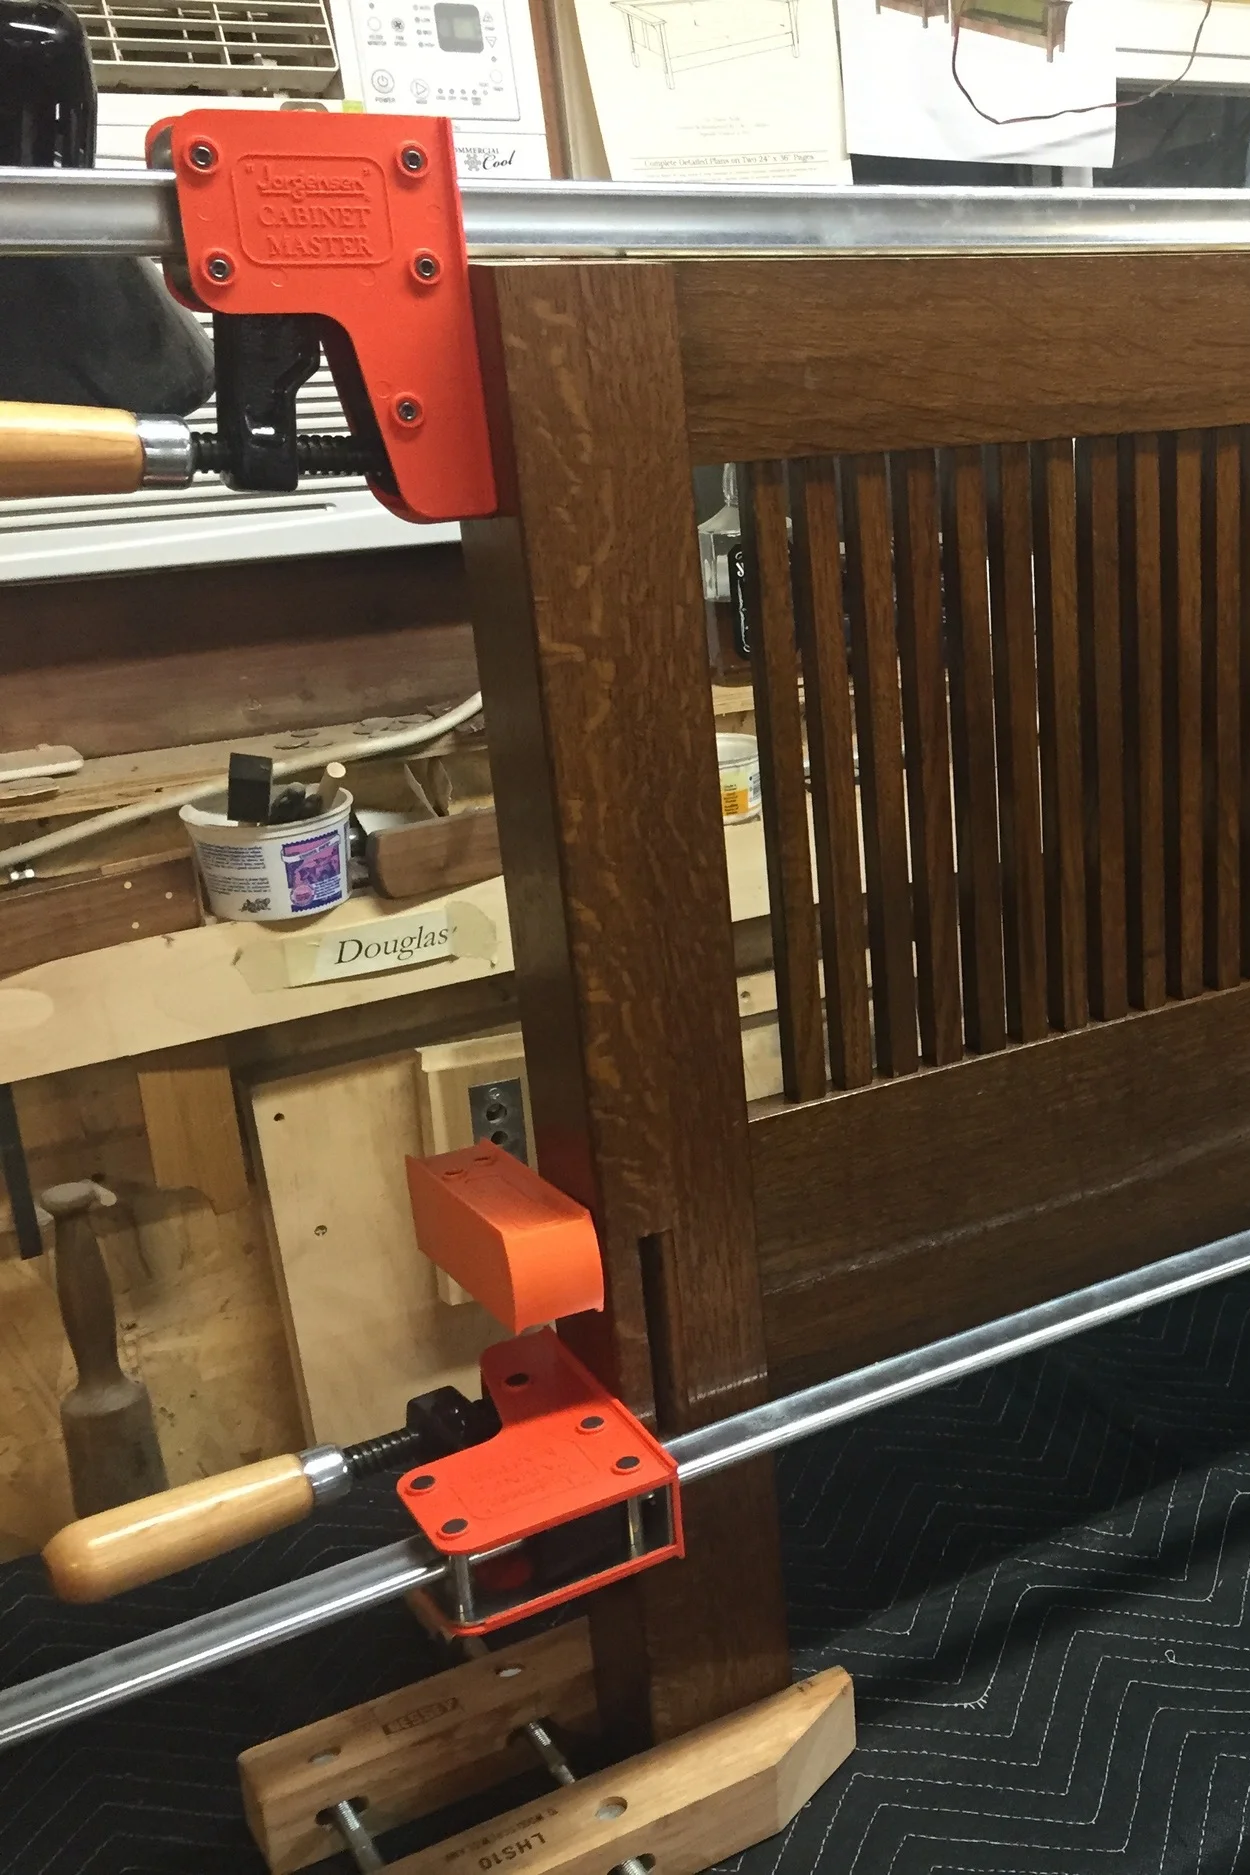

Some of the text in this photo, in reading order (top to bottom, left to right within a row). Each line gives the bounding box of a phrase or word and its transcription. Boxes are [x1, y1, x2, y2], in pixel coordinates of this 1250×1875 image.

[455, 147, 500, 155] OMMERCIAL
[482, 150, 516, 170] Cool
[644, 157, 677, 169] Complete
[678, 156, 708, 167] Detailed
[709, 155, 731, 166] Plans
[731, 157, 742, 165] on
[742, 155, 758, 165] Two
[793, 153, 815, 164] Pages
[259, 204, 372, 229] CABINET
[266, 234, 374, 258] MASTER
[334, 926, 457, 965] Douglas'
[477, 1831, 547, 1872] LHS10
